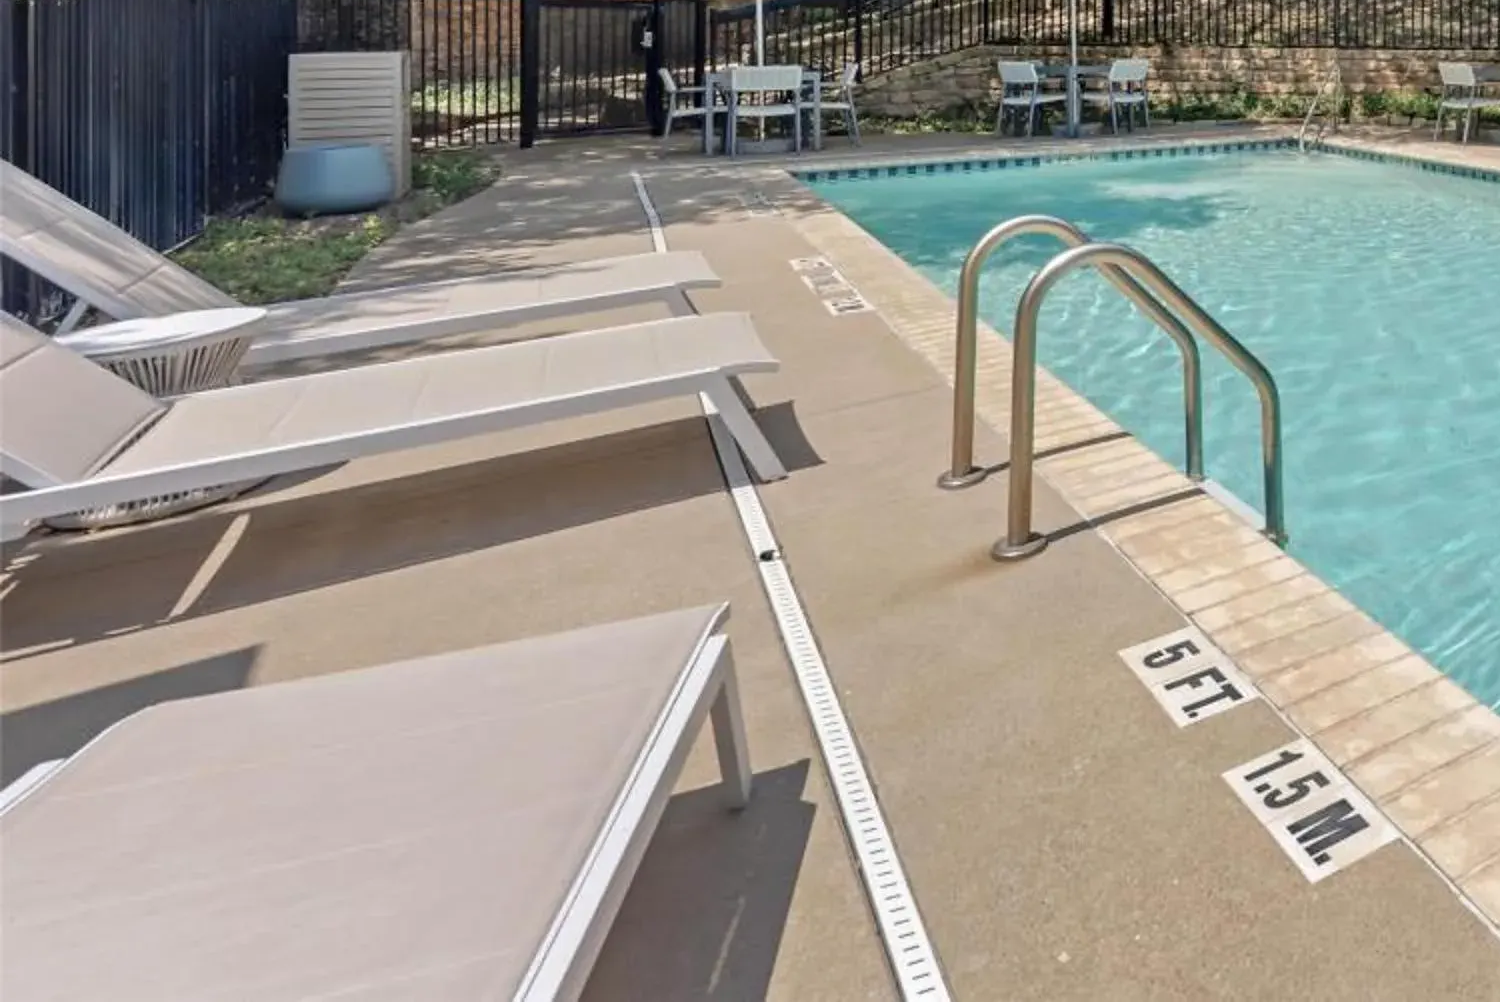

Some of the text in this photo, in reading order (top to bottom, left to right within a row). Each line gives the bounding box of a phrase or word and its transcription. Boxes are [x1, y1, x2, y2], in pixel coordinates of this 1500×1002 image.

[1142, 639, 1245, 719] 5 FT.
[1243, 749, 1371, 866] 1.5 M.
